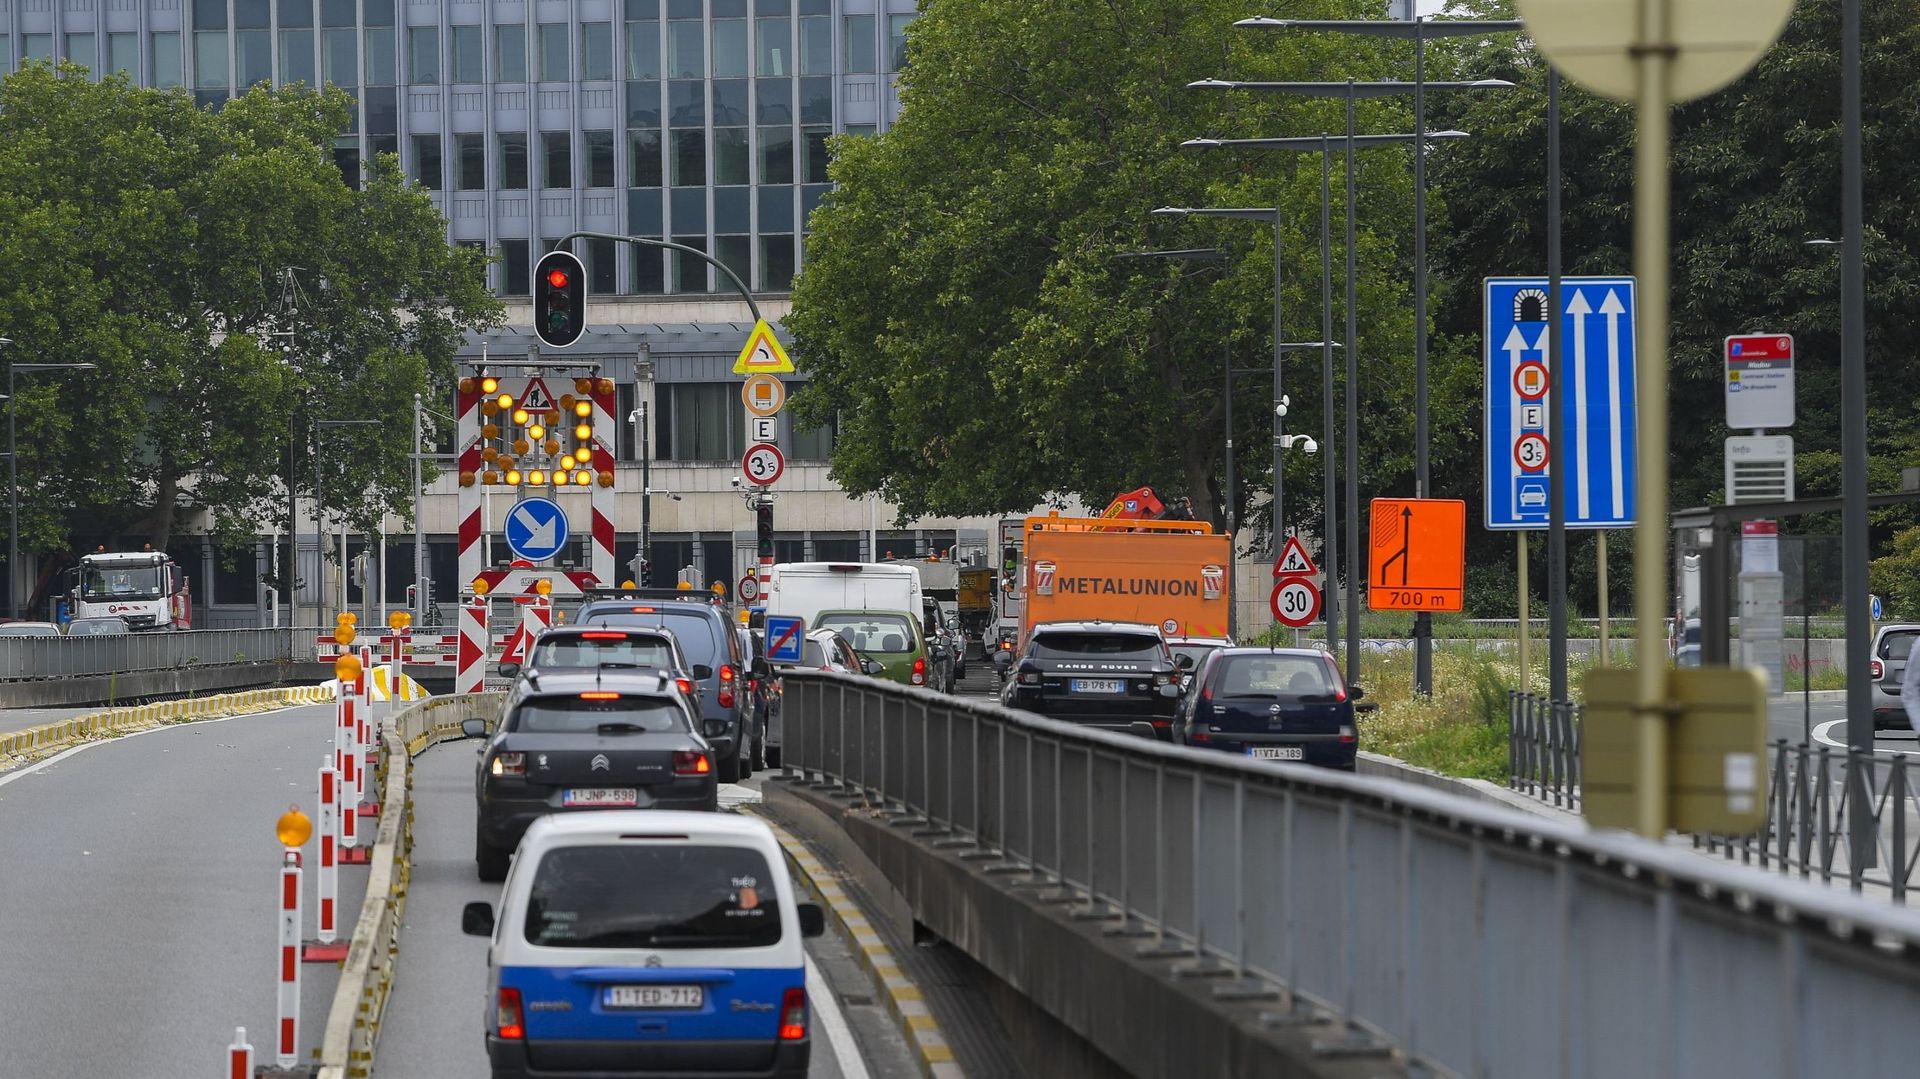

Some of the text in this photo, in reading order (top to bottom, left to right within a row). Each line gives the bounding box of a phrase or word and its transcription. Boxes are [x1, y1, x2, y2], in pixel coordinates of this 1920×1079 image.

[1528, 409, 1536, 424] E
[760, 422, 769, 437] E
[1058, 577, 1198, 596] METALUNION
[1284, 590, 1306, 612] 30
[1390, 592, 1445, 606] 700 m
